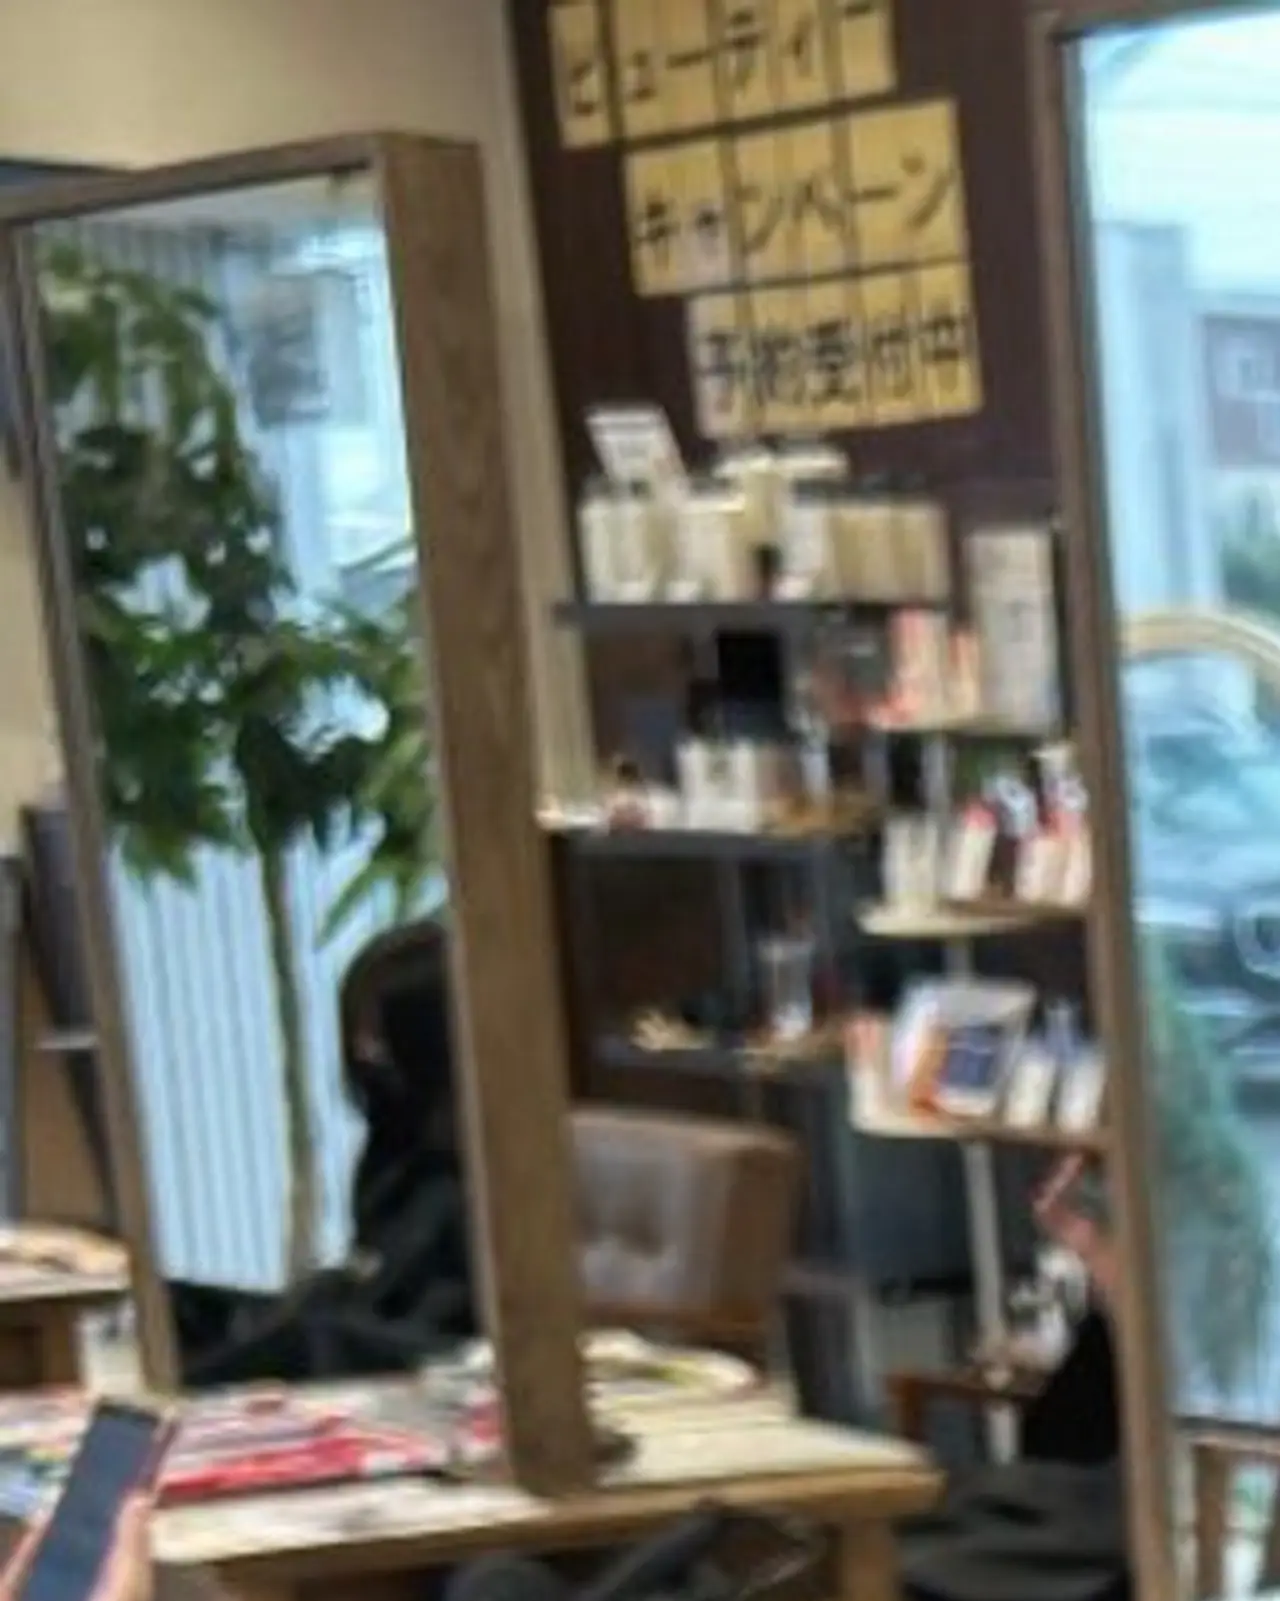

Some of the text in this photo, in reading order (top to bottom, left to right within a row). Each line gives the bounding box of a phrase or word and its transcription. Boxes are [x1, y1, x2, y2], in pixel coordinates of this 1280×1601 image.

[632, 153, 956, 270] キャンペーン
